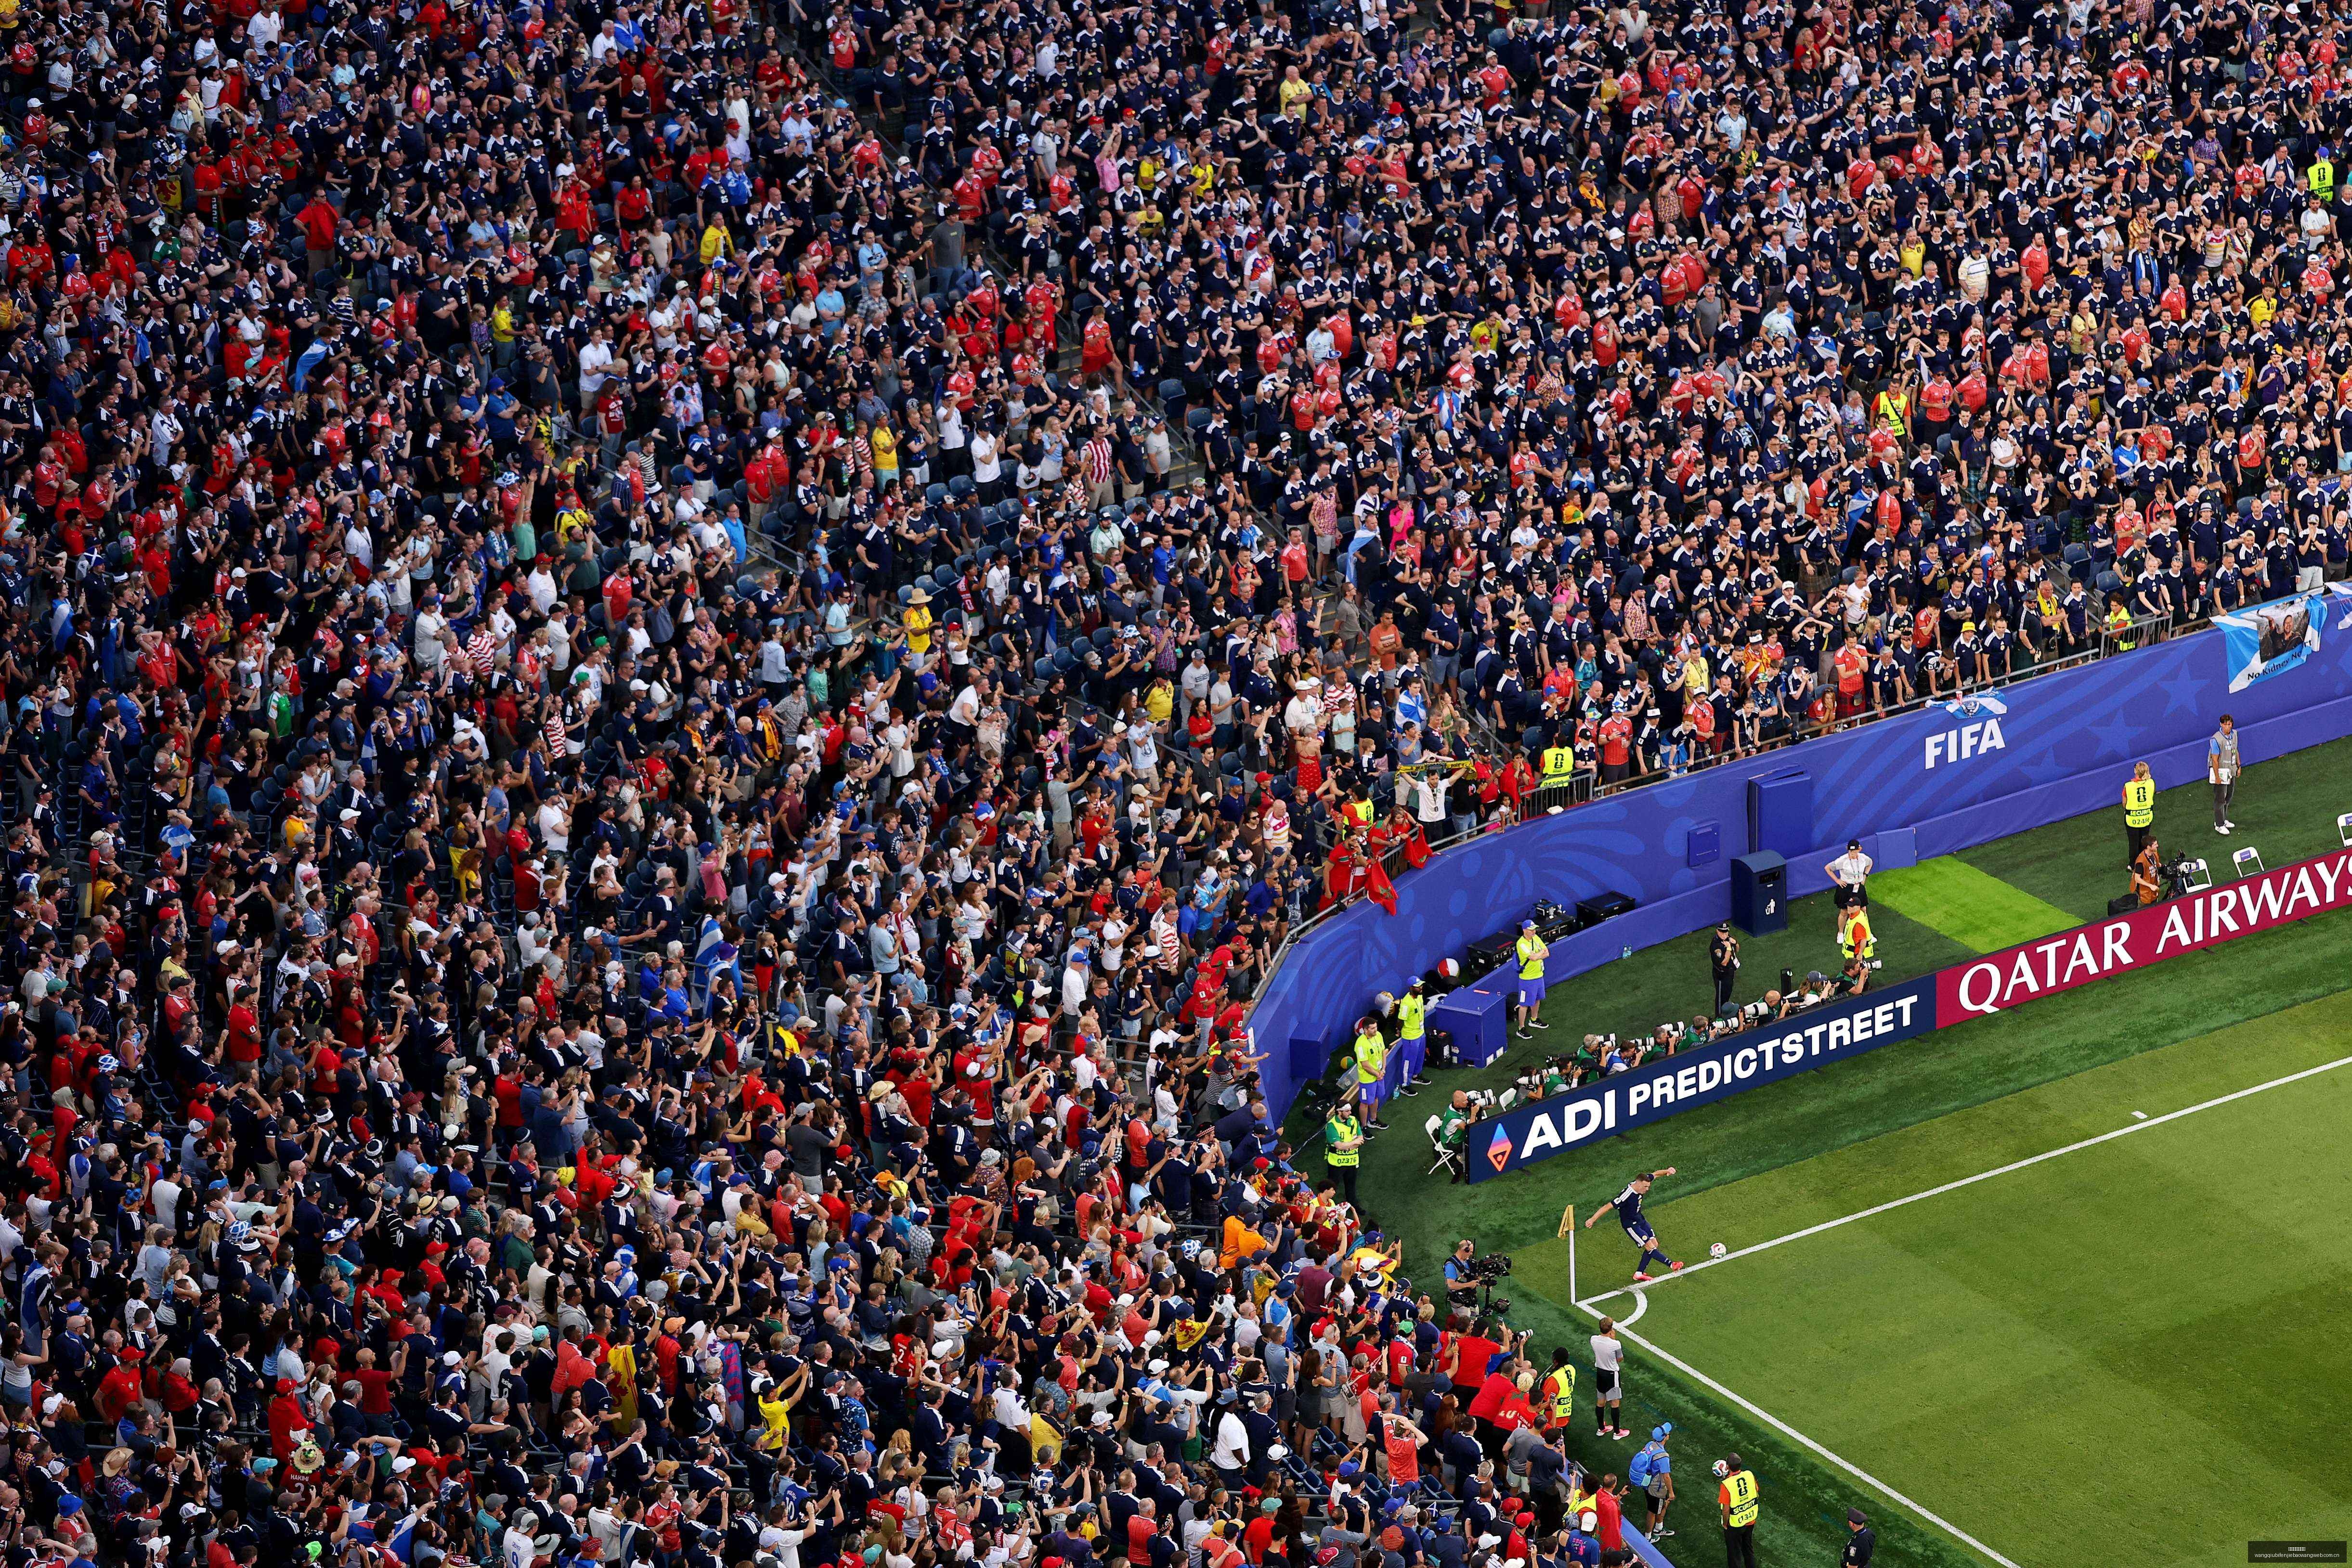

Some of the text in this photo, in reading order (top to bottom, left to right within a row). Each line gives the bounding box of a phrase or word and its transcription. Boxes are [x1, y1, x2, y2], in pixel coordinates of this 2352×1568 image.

[2262, 658, 2289, 676] Kidney
[1925, 718, 2006, 770] FIFA
[1958, 855, 2352, 1013] QATAR AIRWAY
[1520, 995, 1918, 1159] ADI PREDICTSTREET
[290, 1474, 309, 1482] HAKIMI
[1733, 1499, 1755, 1515] SECURITY
